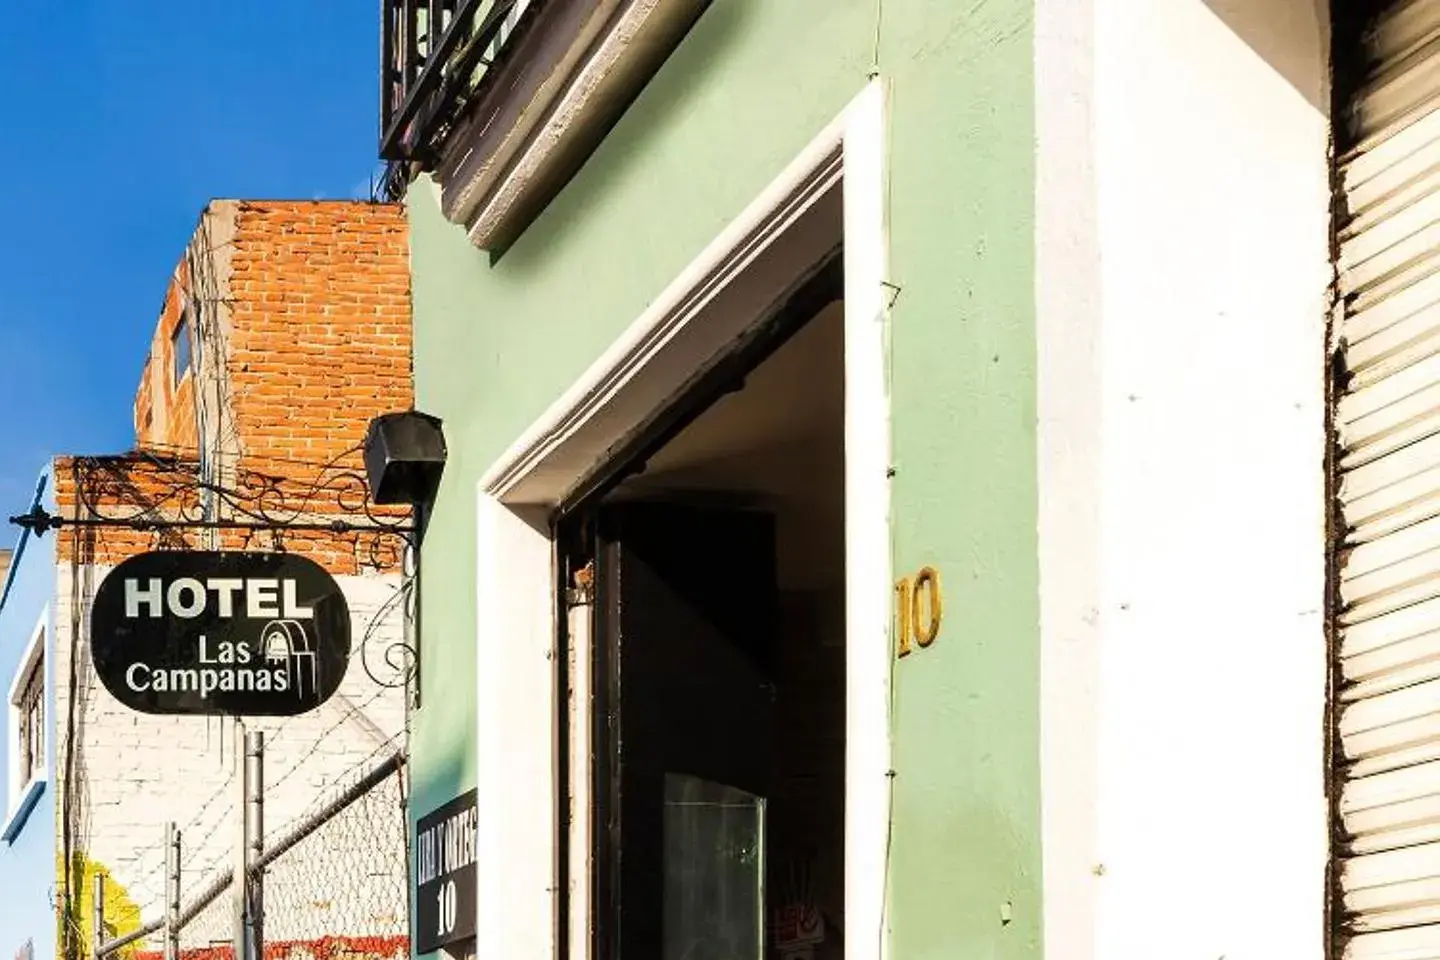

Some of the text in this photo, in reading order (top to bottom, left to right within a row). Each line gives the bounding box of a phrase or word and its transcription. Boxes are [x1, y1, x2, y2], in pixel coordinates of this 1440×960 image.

[124, 577, 314, 619] HOTEL
[895, 566, 940, 659] 10
[199, 634, 251, 664] Las
[125, 661, 287, 698] Campanas
[437, 879, 457, 936] 10
